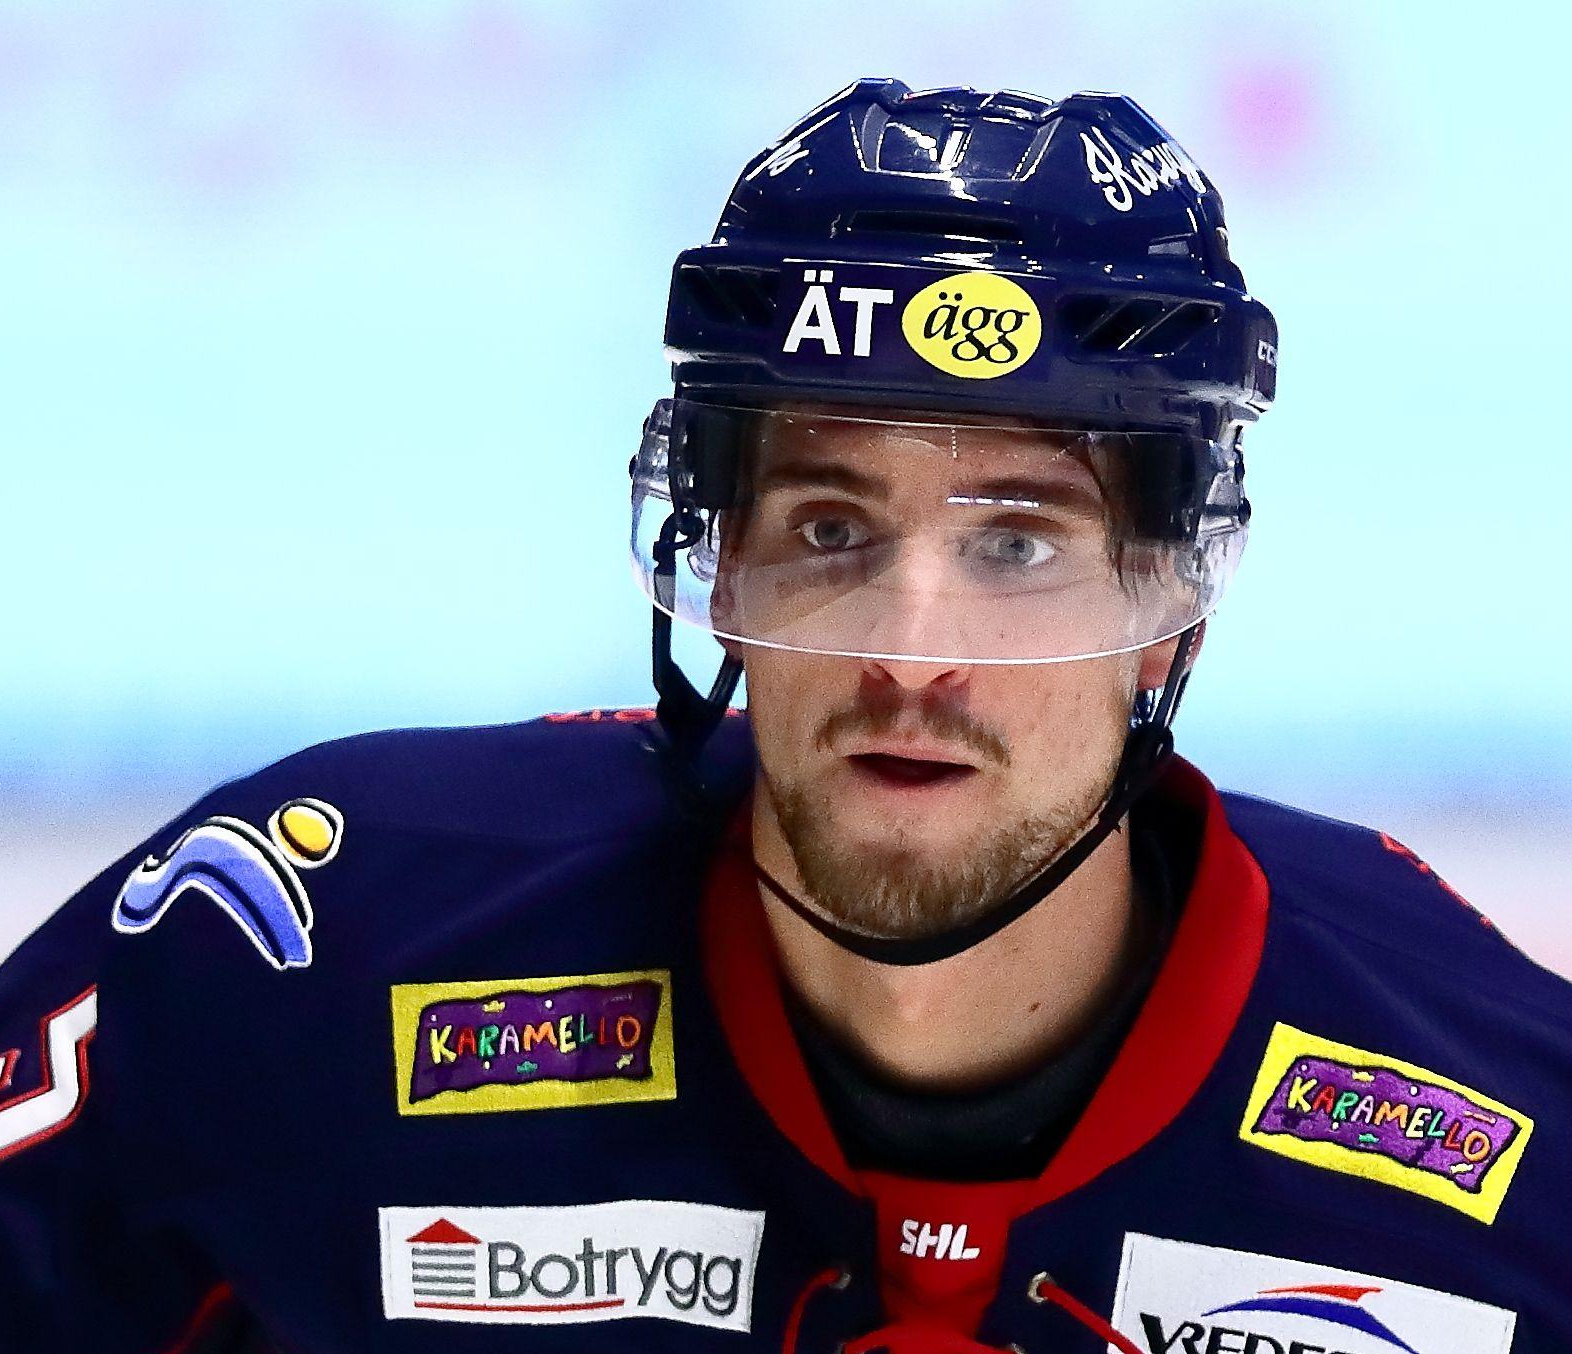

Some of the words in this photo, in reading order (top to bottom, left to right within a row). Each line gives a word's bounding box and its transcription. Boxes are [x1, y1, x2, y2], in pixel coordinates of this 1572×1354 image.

[782, 269, 895, 356] ÄT
[922, 290, 1031, 363] ägg
[1257, 339, 1278, 366] CC
[1286, 1075, 1492, 1163] KARAMELLO
[487, 1237, 742, 1317] Botrygg
[899, 1218, 981, 1261] SHL
